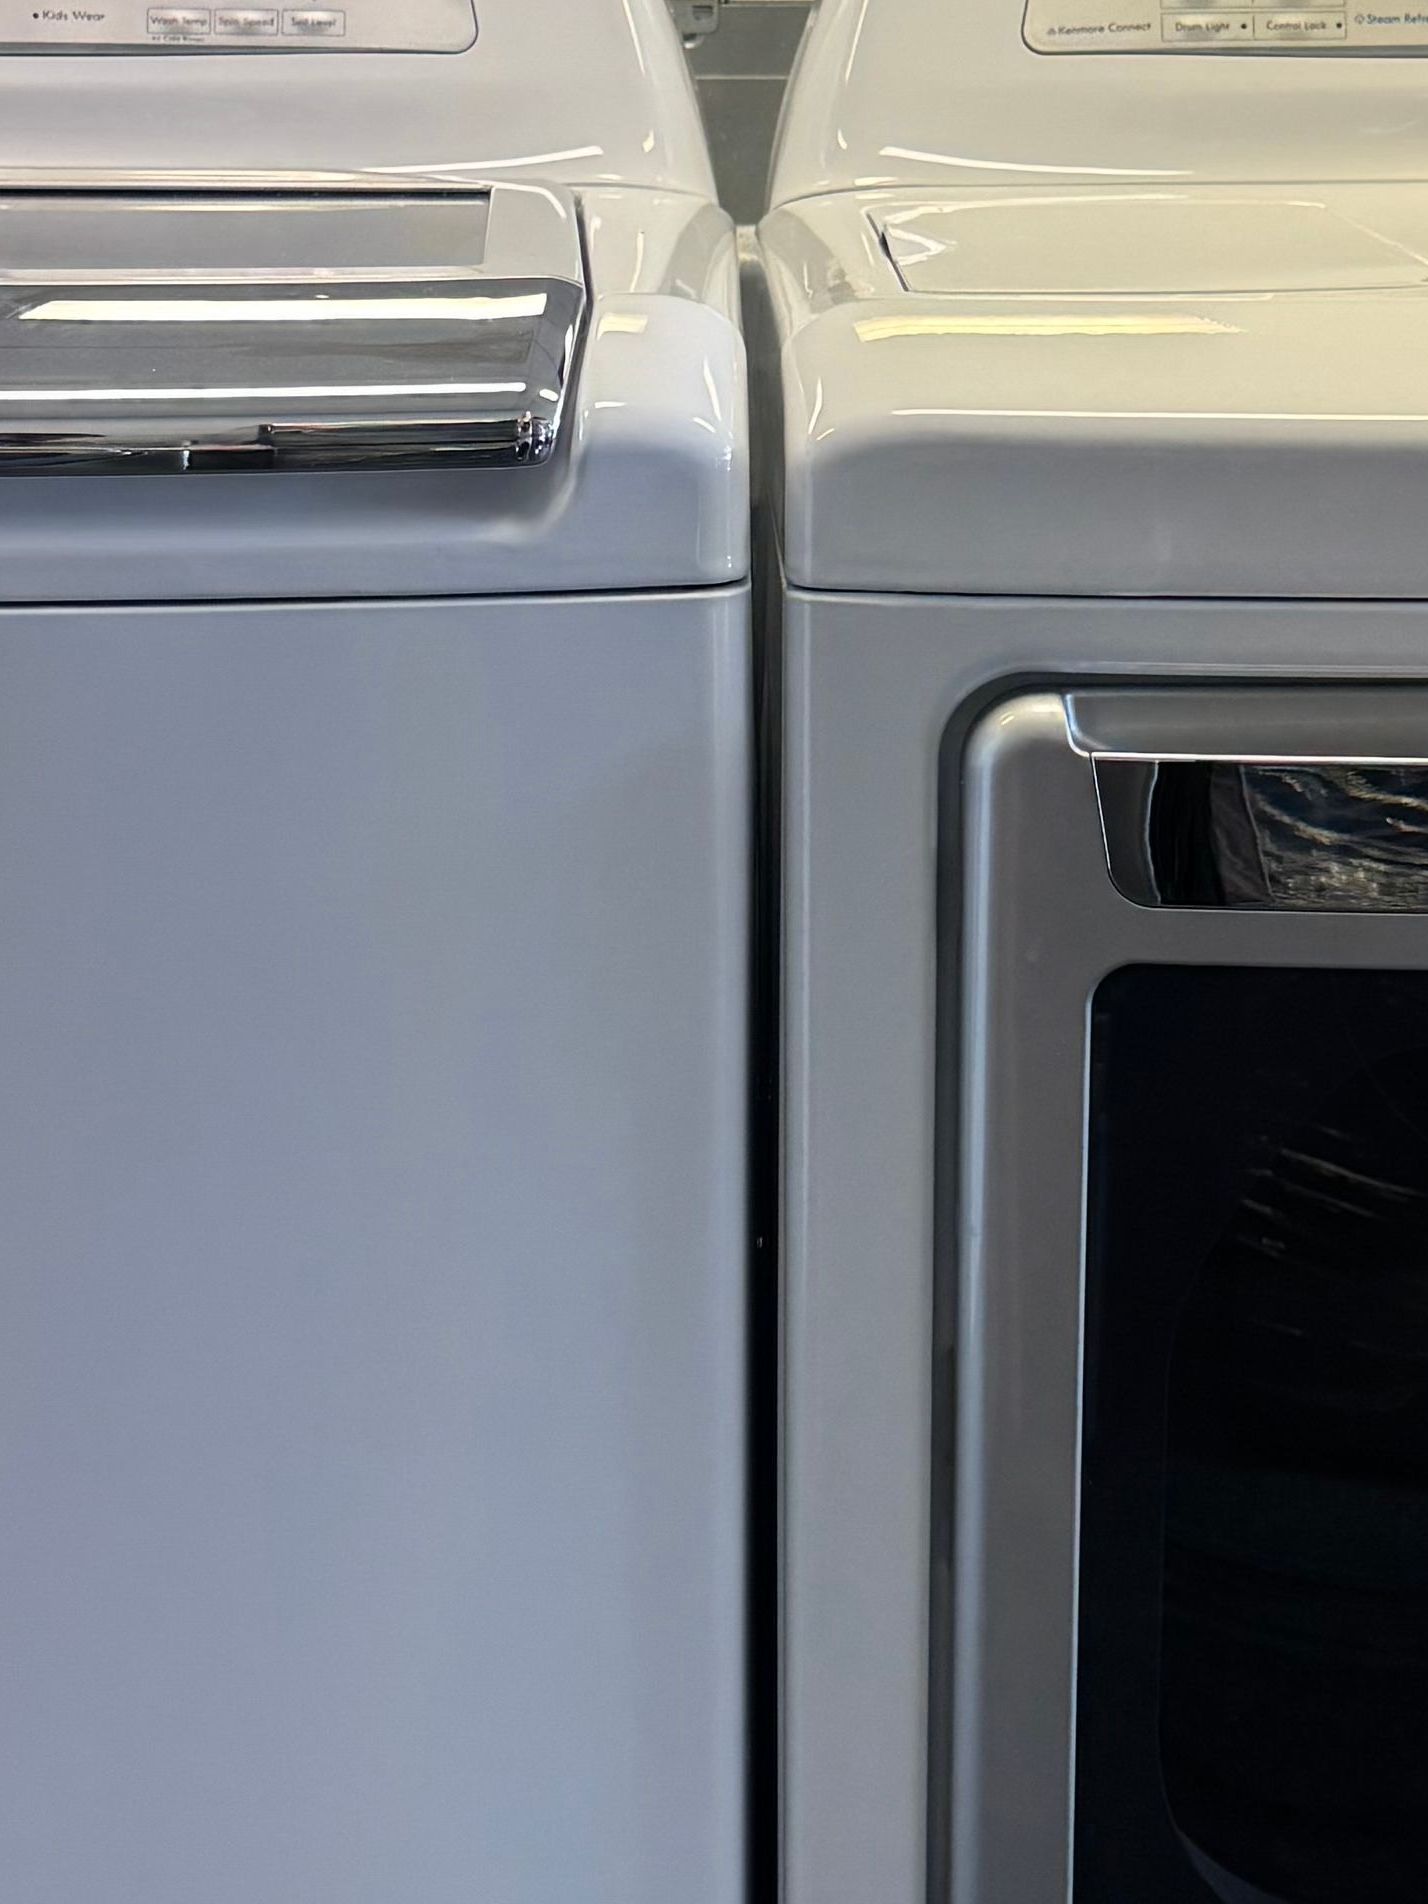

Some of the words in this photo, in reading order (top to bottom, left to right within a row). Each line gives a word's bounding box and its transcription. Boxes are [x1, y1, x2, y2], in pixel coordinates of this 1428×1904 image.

[42, 10, 68, 21] Kids
[72, 11, 105, 21] Wear
[1367, 13, 1401, 24] Steam
[1058, 25, 1105, 35] Kenmore
[1108, 22, 1152, 33] Connect
[1175, 22, 1203, 31] Drum
[1205, 22, 1230, 33] Light
[1266, 21, 1301, 31] Control
[1304, 20, 1327, 31] Lock
